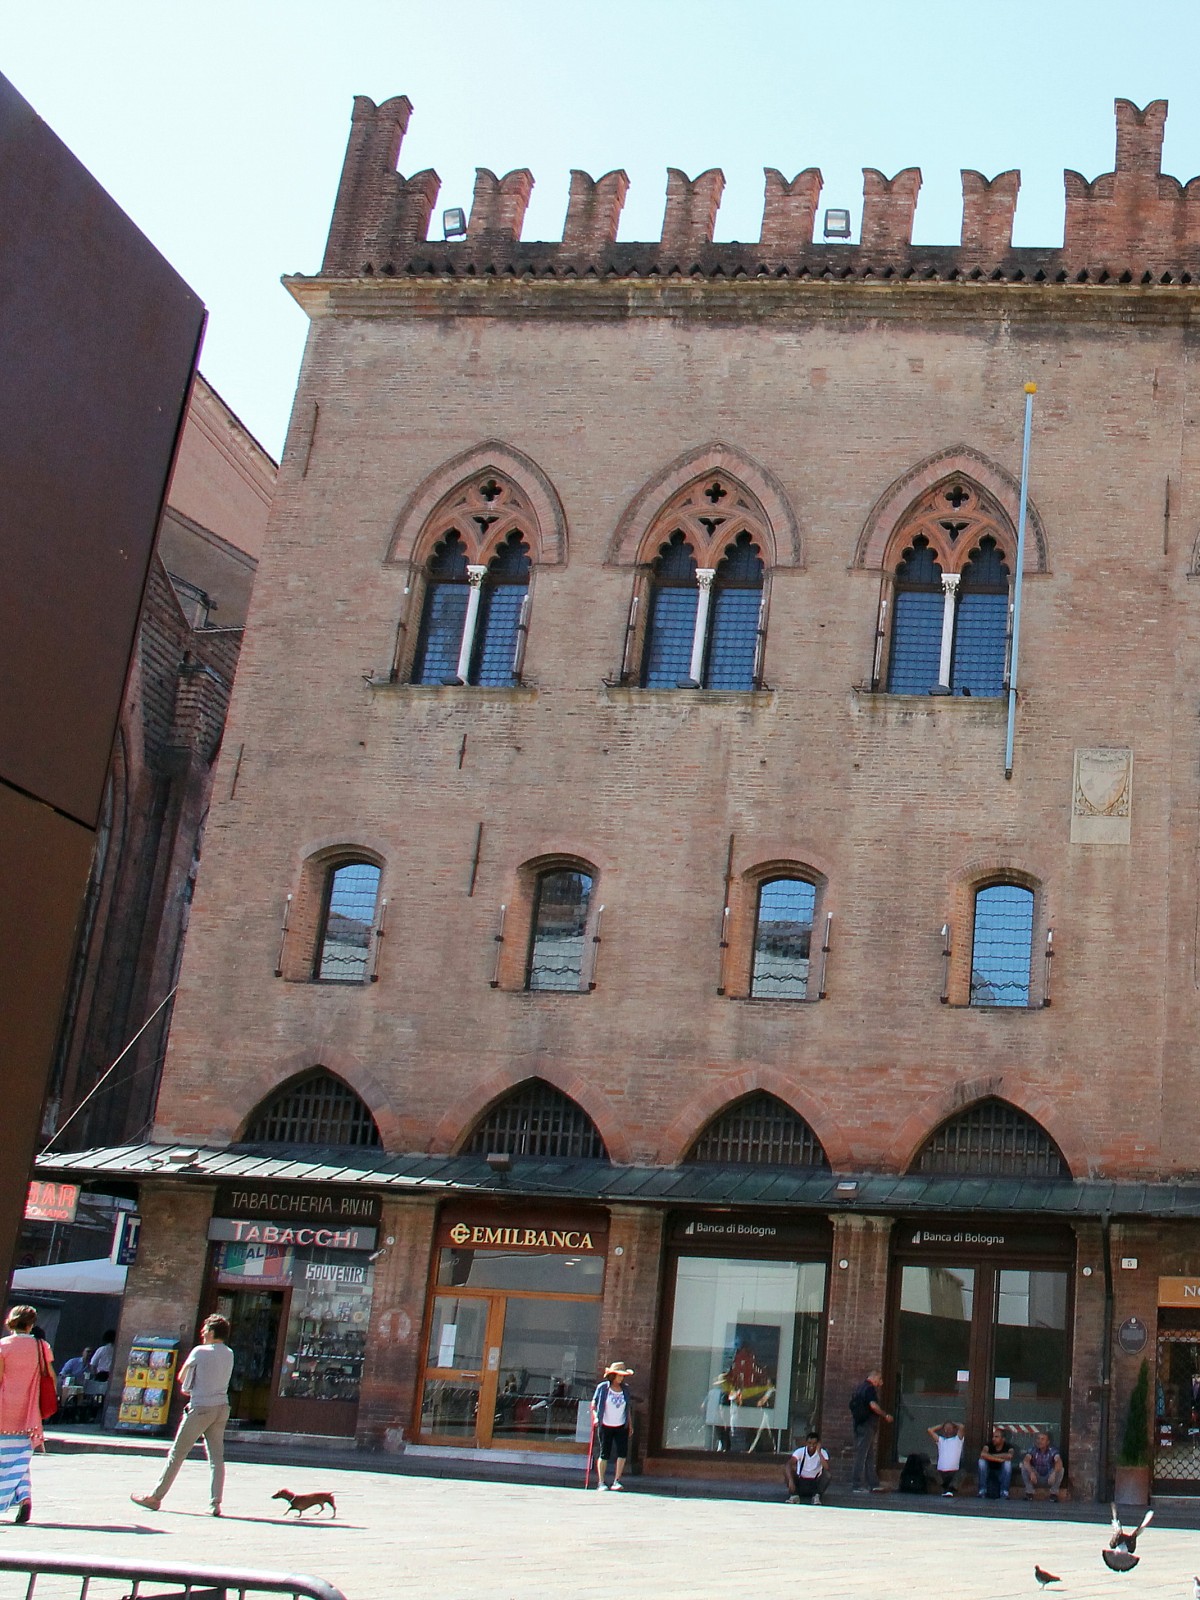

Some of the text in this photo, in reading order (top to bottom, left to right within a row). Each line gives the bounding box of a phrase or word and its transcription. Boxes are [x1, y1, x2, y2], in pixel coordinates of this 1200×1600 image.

[231, 1191, 332, 1214] TABACCHERIA
[231, 1220, 358, 1248] TABACCHI
[471, 1226, 594, 1249] EMILBANCA
[696, 1222, 777, 1237] Banca di Bologna
[923, 1231, 1005, 1246] Banca di Bologna
[307, 1265, 363, 1282] SOUVENIR
